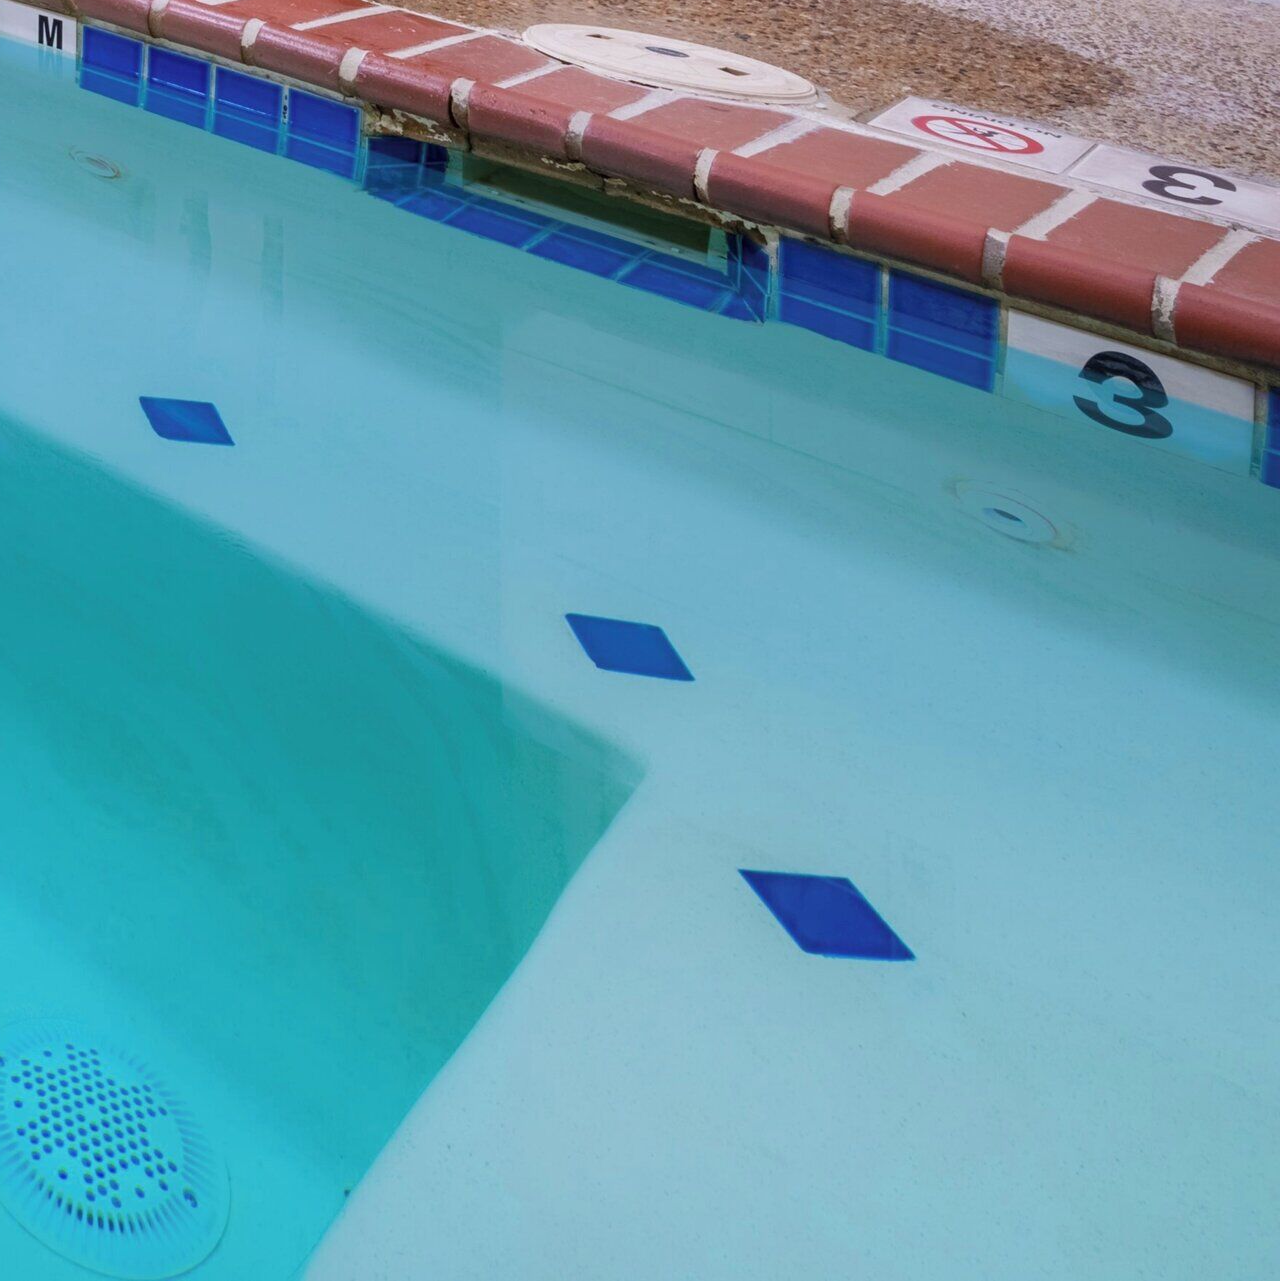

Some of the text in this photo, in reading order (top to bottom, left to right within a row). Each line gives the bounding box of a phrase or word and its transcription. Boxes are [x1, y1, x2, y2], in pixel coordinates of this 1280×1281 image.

[38, 14, 63, 50] M
[931, 104, 1062, 139] NO DIVING
[1141, 165, 1237, 206] 3
[1072, 350, 1174, 439] 3
